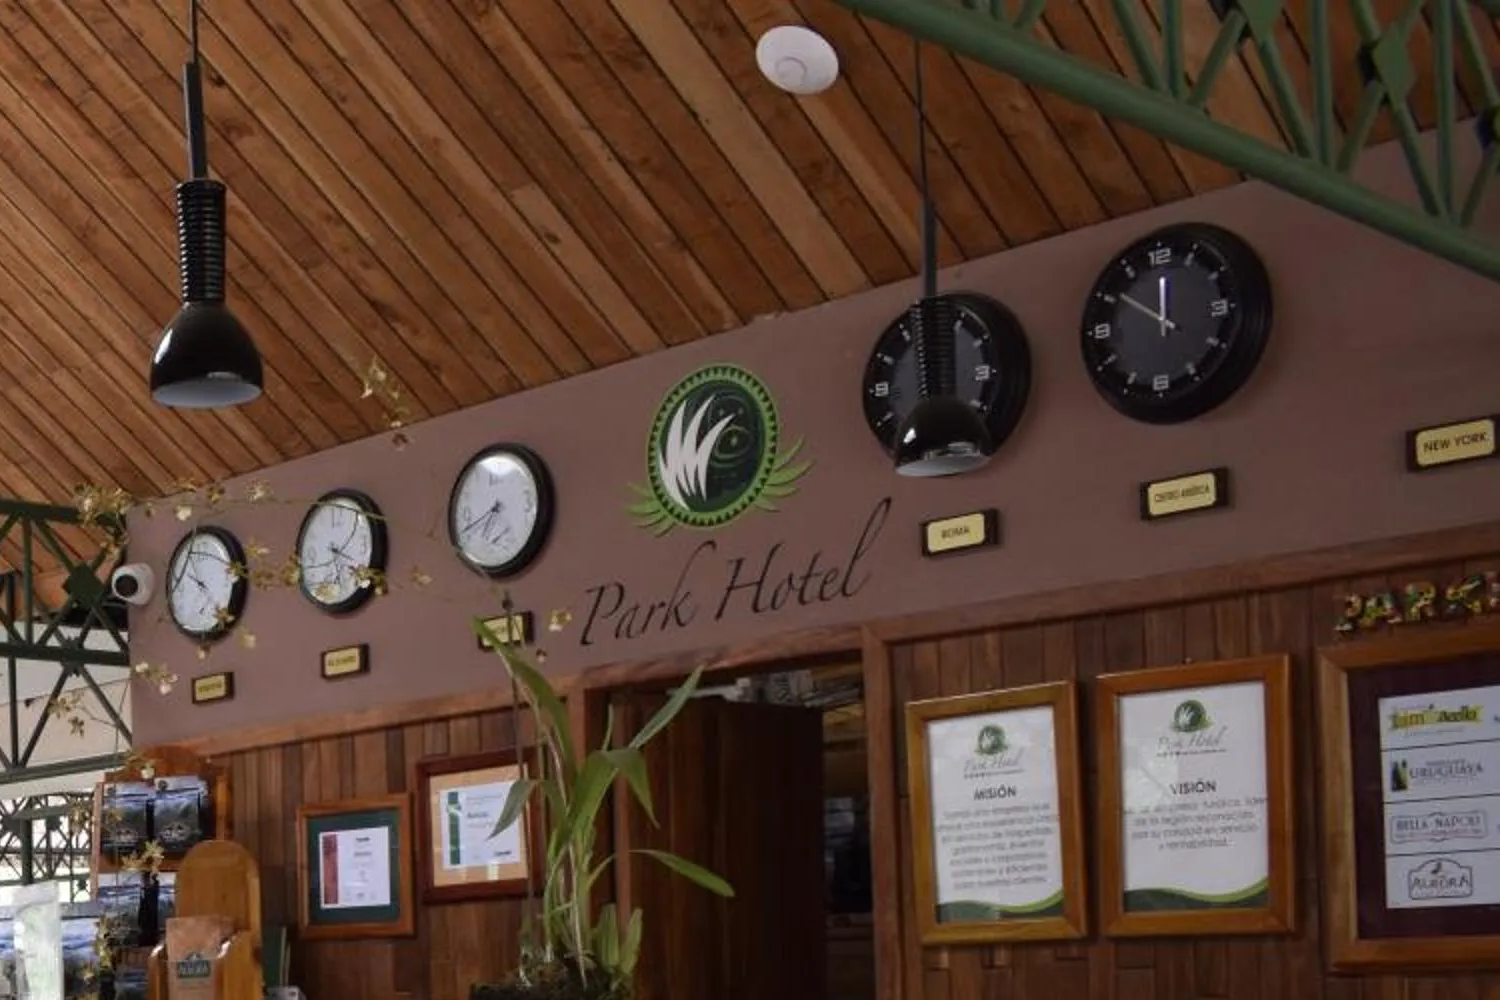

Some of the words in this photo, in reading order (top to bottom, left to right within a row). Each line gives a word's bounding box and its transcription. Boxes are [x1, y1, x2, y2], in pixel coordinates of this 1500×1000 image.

[1147, 247, 1172, 265] 12
[1210, 299, 1228, 317] 3
[1423, 438, 1450, 453] NEW
[1453, 431, 1488, 448] YORK
[579, 539, 717, 646] Park
[714, 496, 893, 621] Hotel
[973, 785, 1017, 801] MISIÓN
[1168, 779, 1217, 796] VISIÓN
